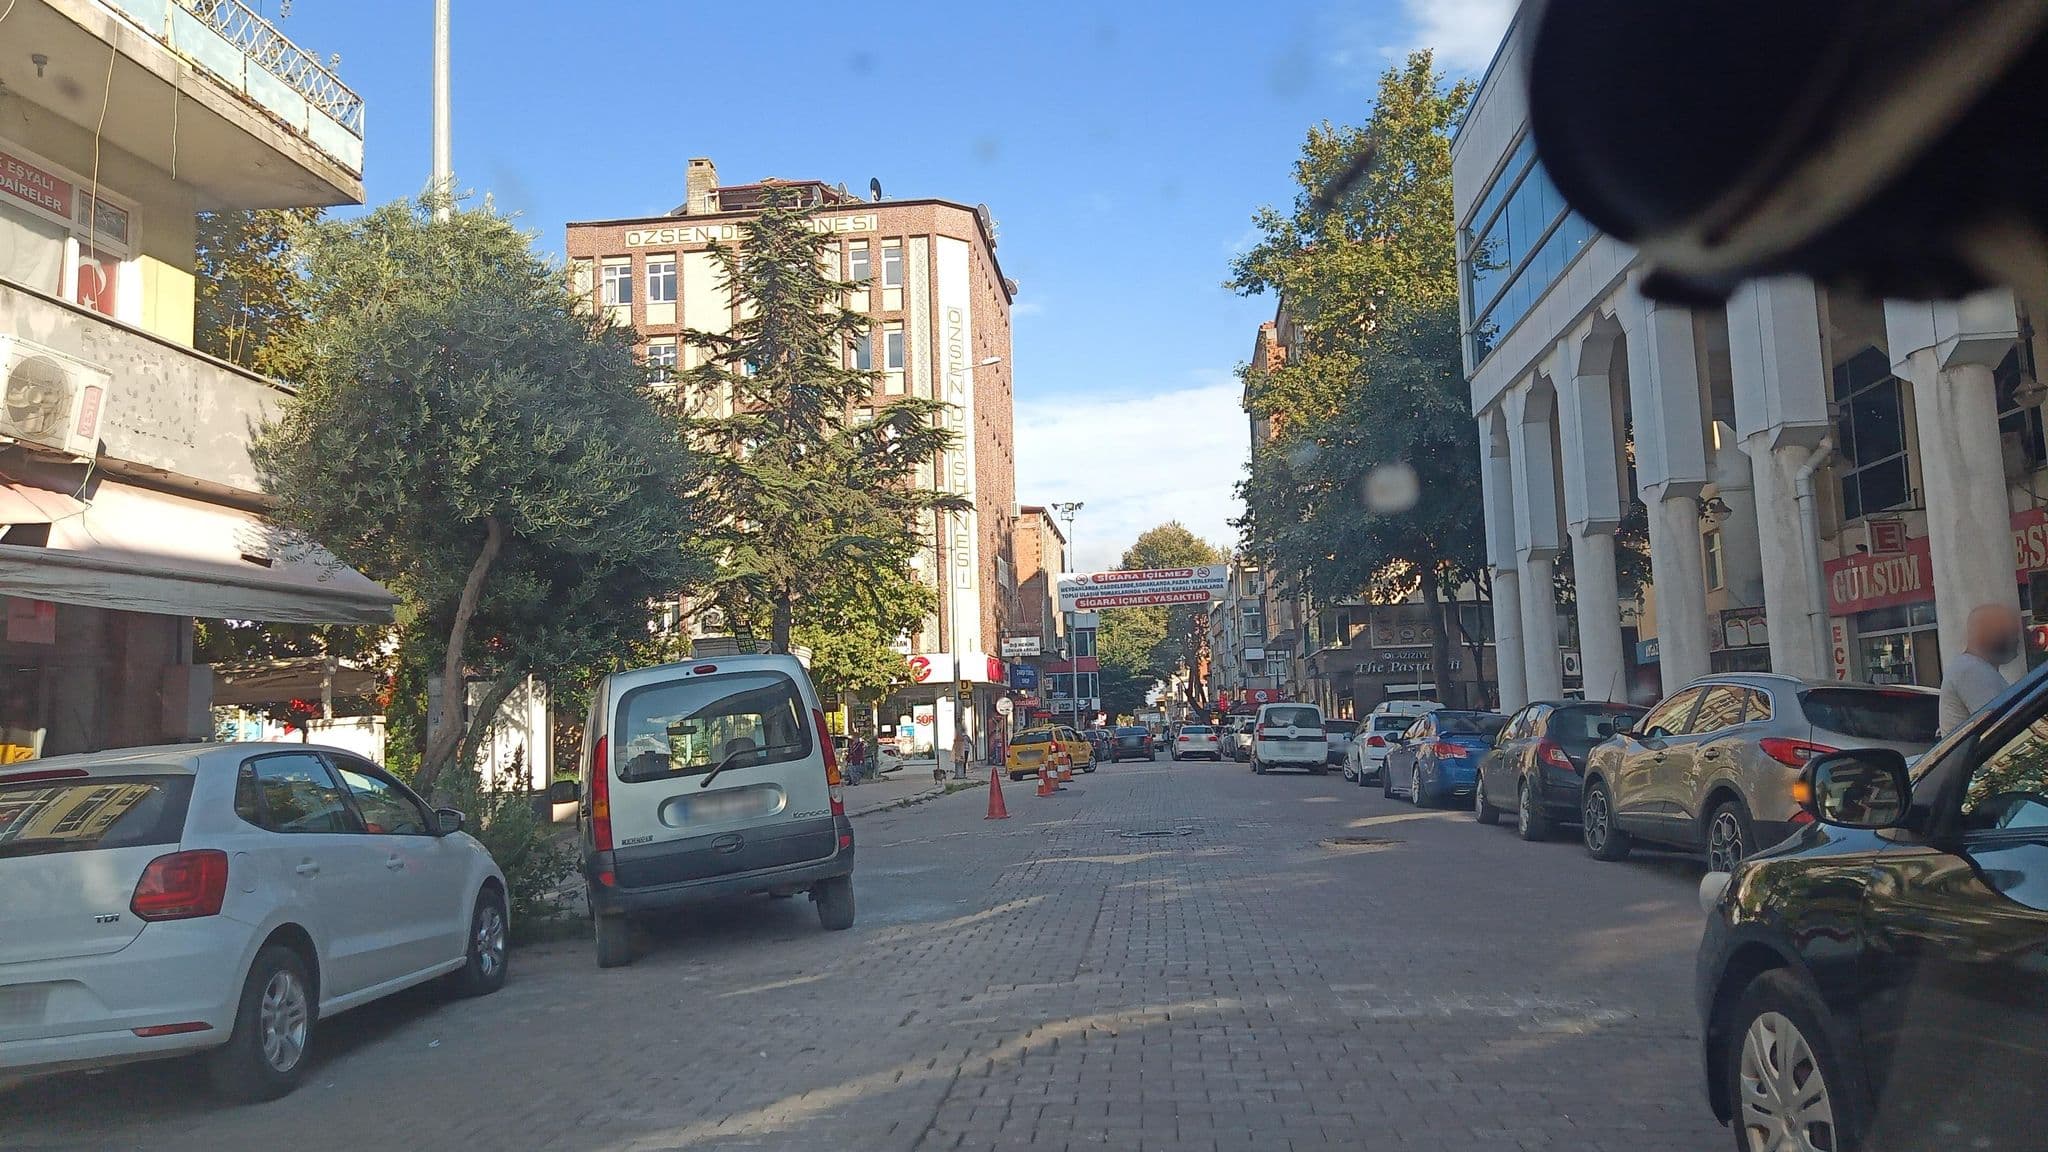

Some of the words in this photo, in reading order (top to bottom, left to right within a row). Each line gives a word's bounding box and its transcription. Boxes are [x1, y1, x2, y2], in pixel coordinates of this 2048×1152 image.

[8, 160, 54, 191] EŞYALI
[1097, 571, 1140, 582] SİGARA
[1142, 569, 1189, 580] İÇİLMEZ
[1832, 553, 1922, 605] GÜLSUM
[1079, 598, 1116, 607] SİGARA
